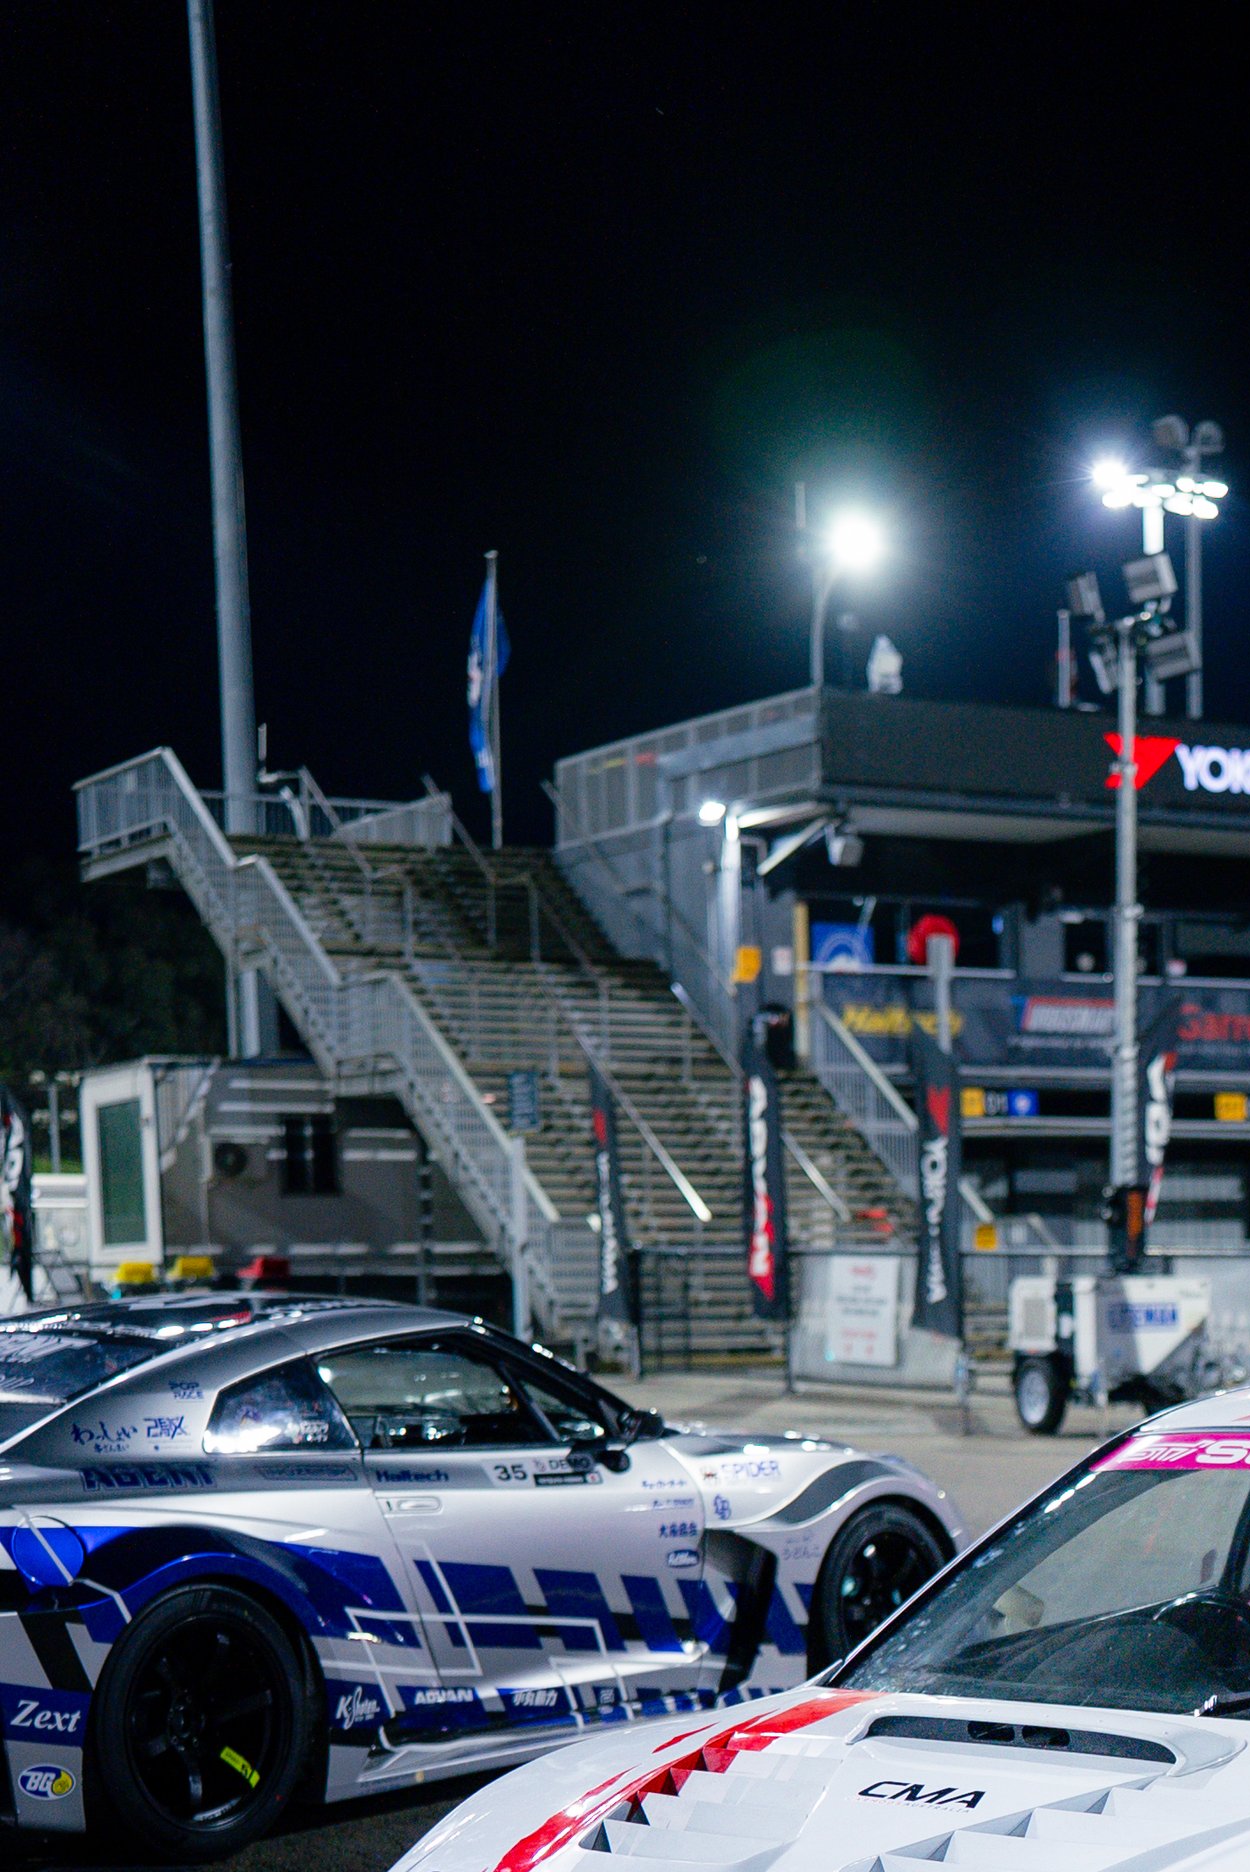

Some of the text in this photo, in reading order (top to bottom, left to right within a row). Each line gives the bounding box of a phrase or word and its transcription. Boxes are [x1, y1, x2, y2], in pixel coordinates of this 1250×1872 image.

[376, 1469, 449, 1484] Haltech
[494, 1464, 528, 1481] 35
[414, 1688, 473, 1705] ADVAN
[10, 1699, 81, 1733] Zext
[26, 1771, 56, 1791] BG
[858, 1781, 986, 1809] CMA
